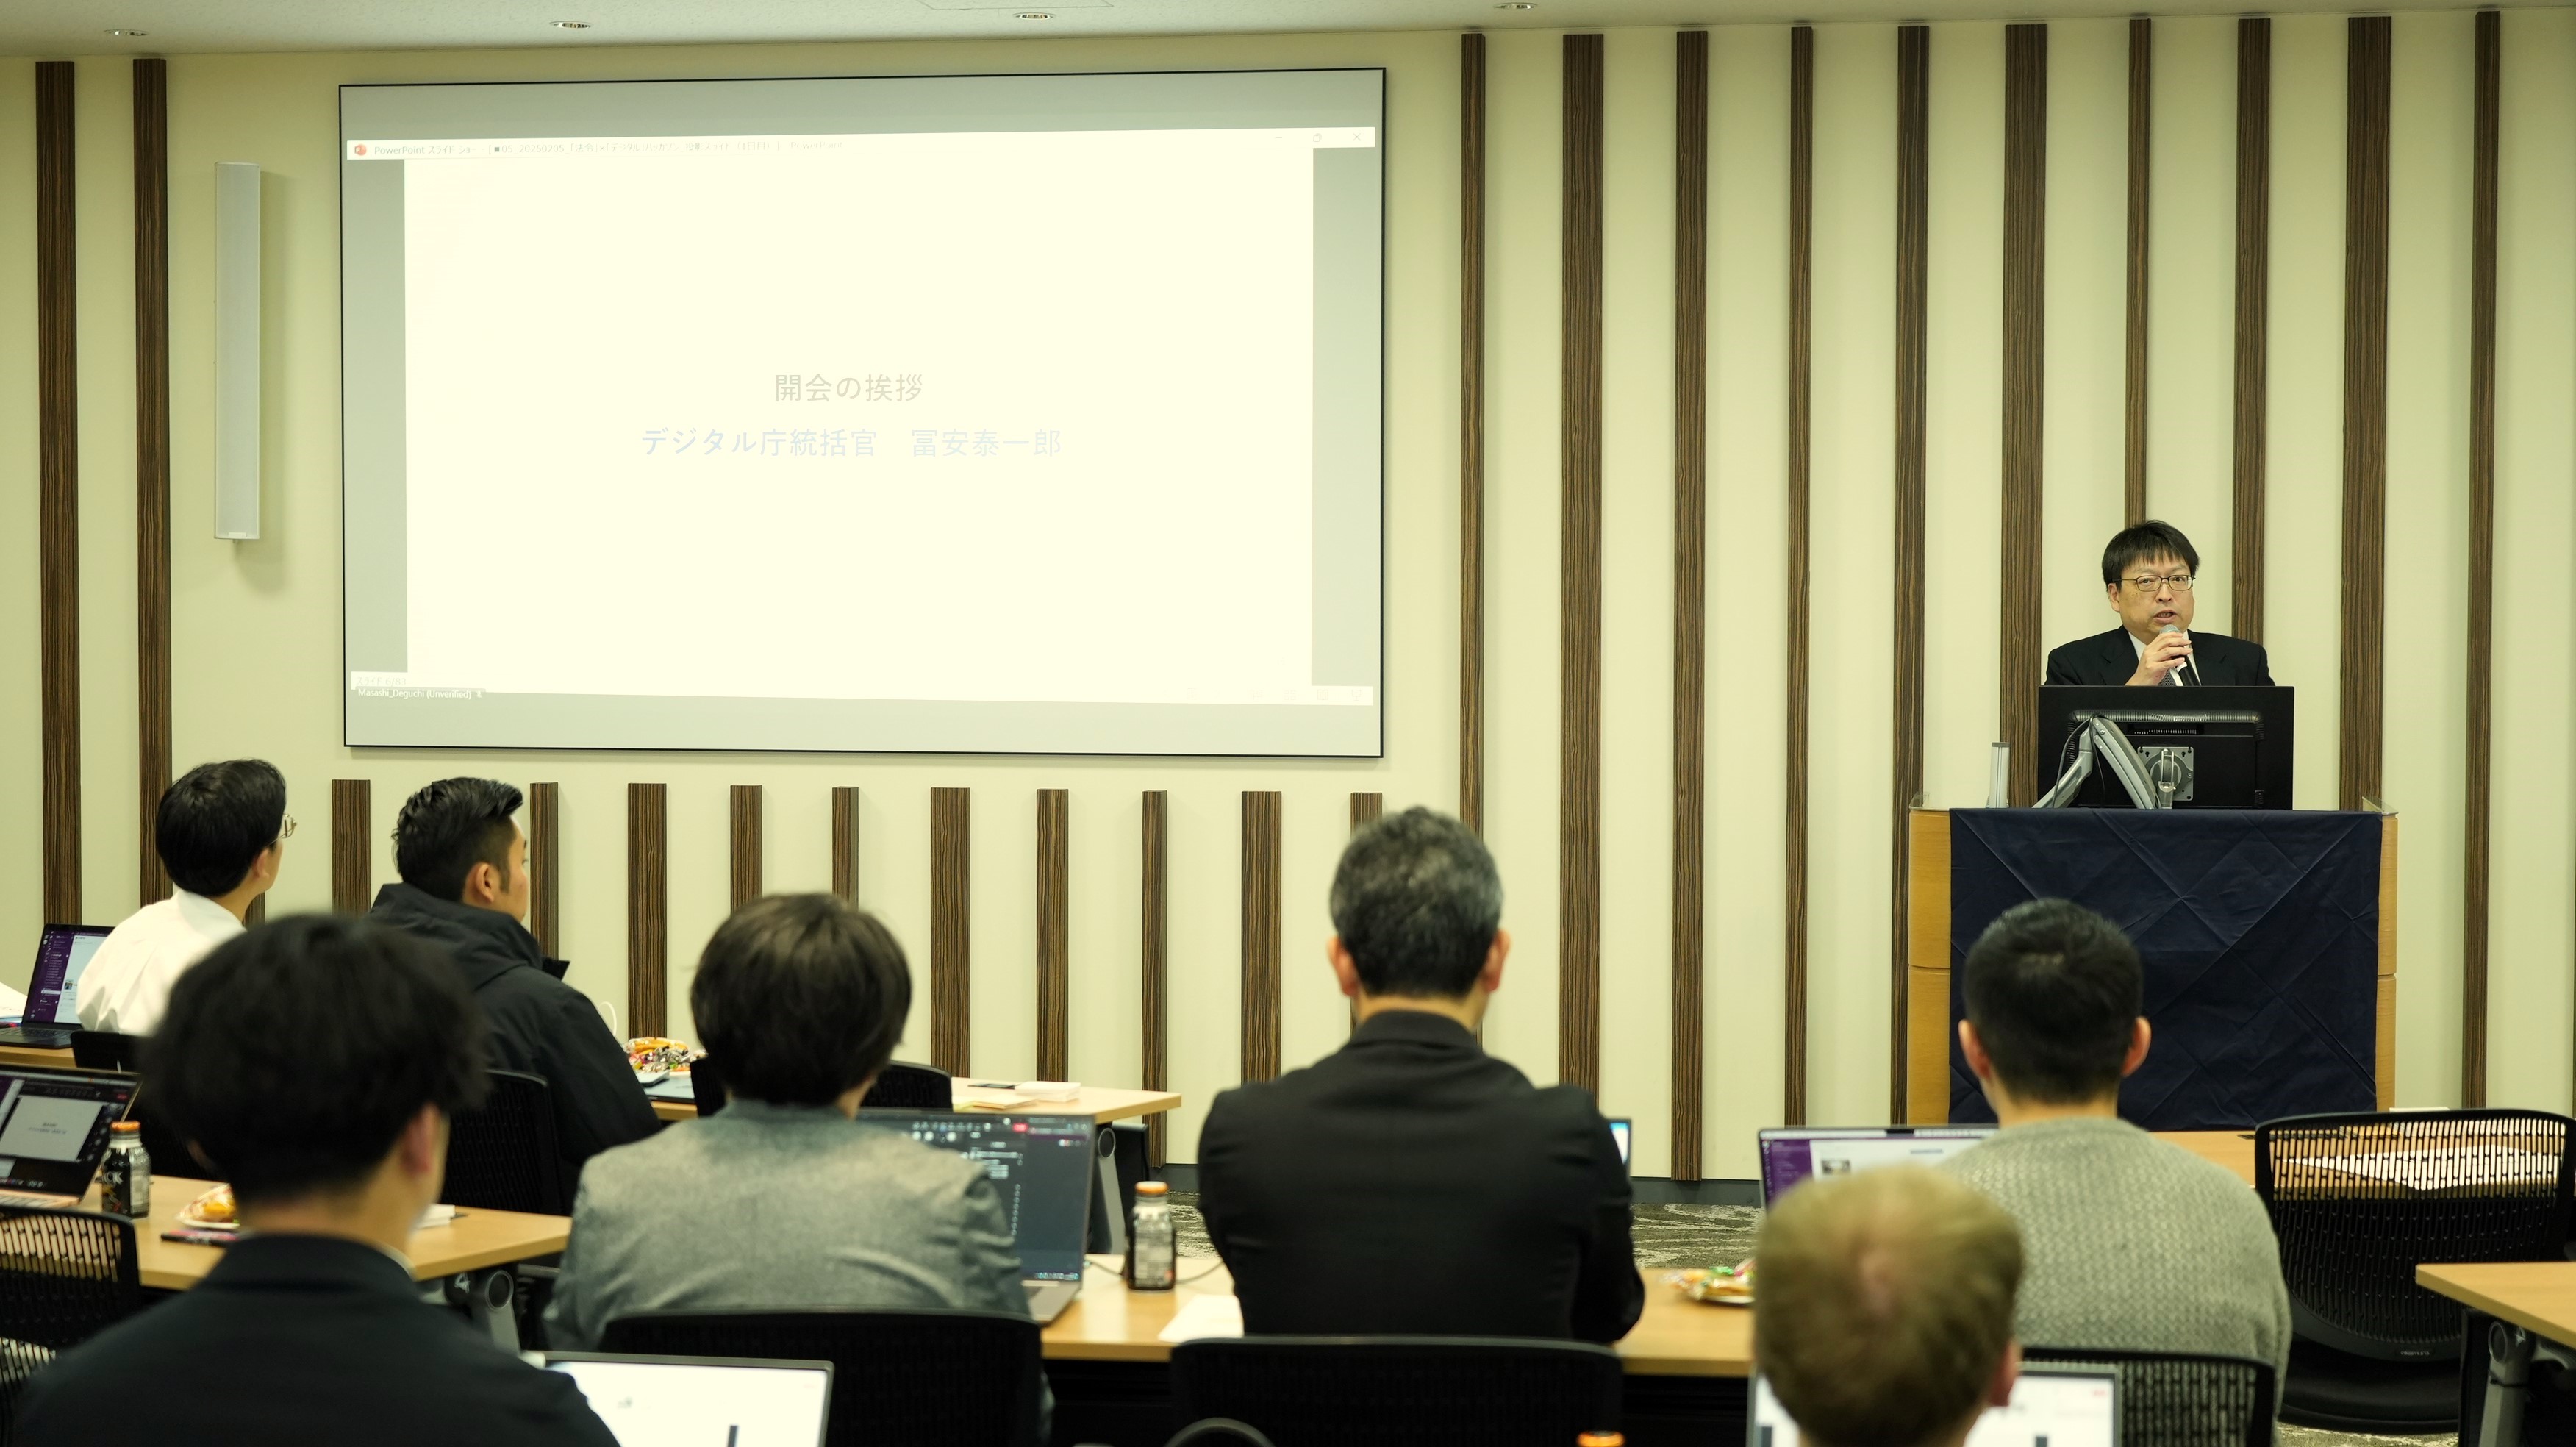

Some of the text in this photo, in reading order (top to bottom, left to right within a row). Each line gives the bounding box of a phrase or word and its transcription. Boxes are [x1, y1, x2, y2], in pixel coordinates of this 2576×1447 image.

[374, 146, 425, 154] PowerPoint
[775, 373, 923, 402] 開会の挨拶
[642, 426, 878, 457] デジタル庁統括官
[358, 688, 472, 700] Masashi_Deguchi (Unverified)
